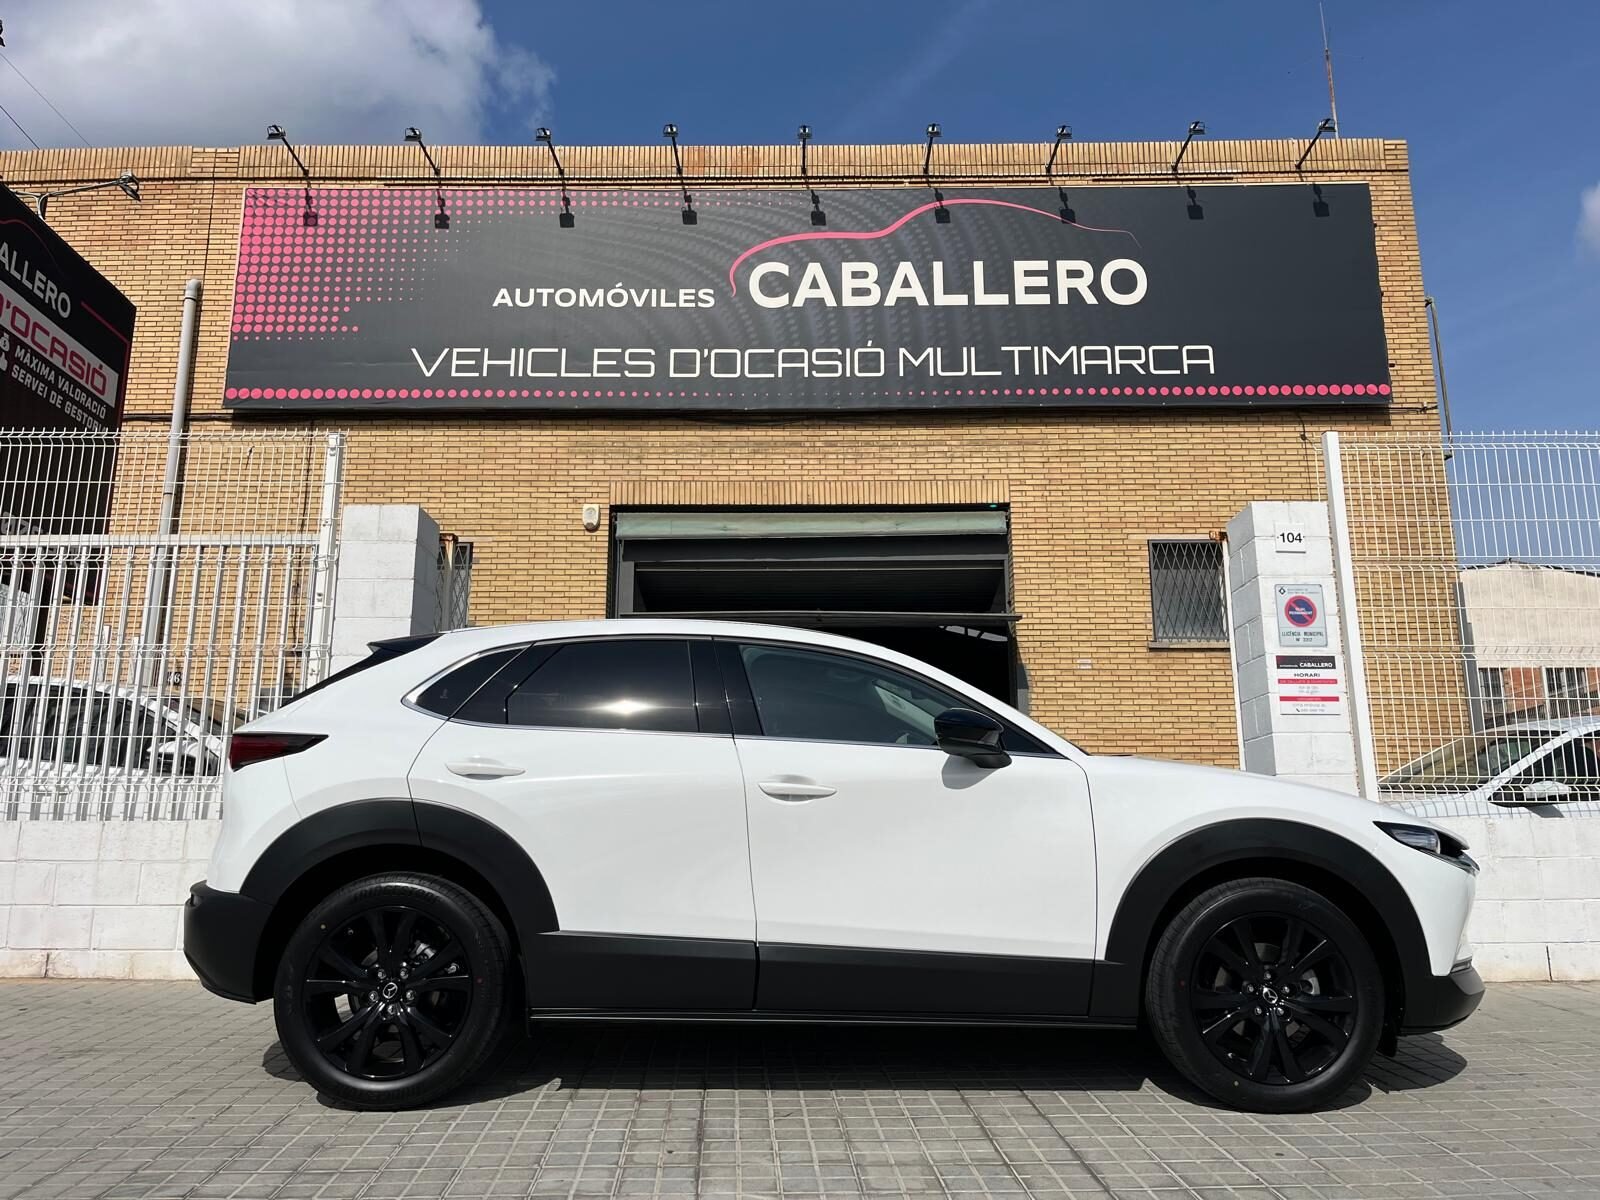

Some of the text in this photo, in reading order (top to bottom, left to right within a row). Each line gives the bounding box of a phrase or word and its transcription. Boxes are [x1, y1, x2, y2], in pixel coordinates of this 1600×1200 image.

[492, 257, 1149, 309] AUTOMÓVILES CABALLERO
[0, 293, 107, 397] 'OCASIÓ
[410, 339, 1216, 379] VEHICLES D'OCASIÓ MULTIMARCA
[11, 364, 48, 399] SERVEI
[49, 391, 63, 409] DE
[58, 375, 106, 419] VALORACIÓ
[1279, 533, 1303, 543] 104
